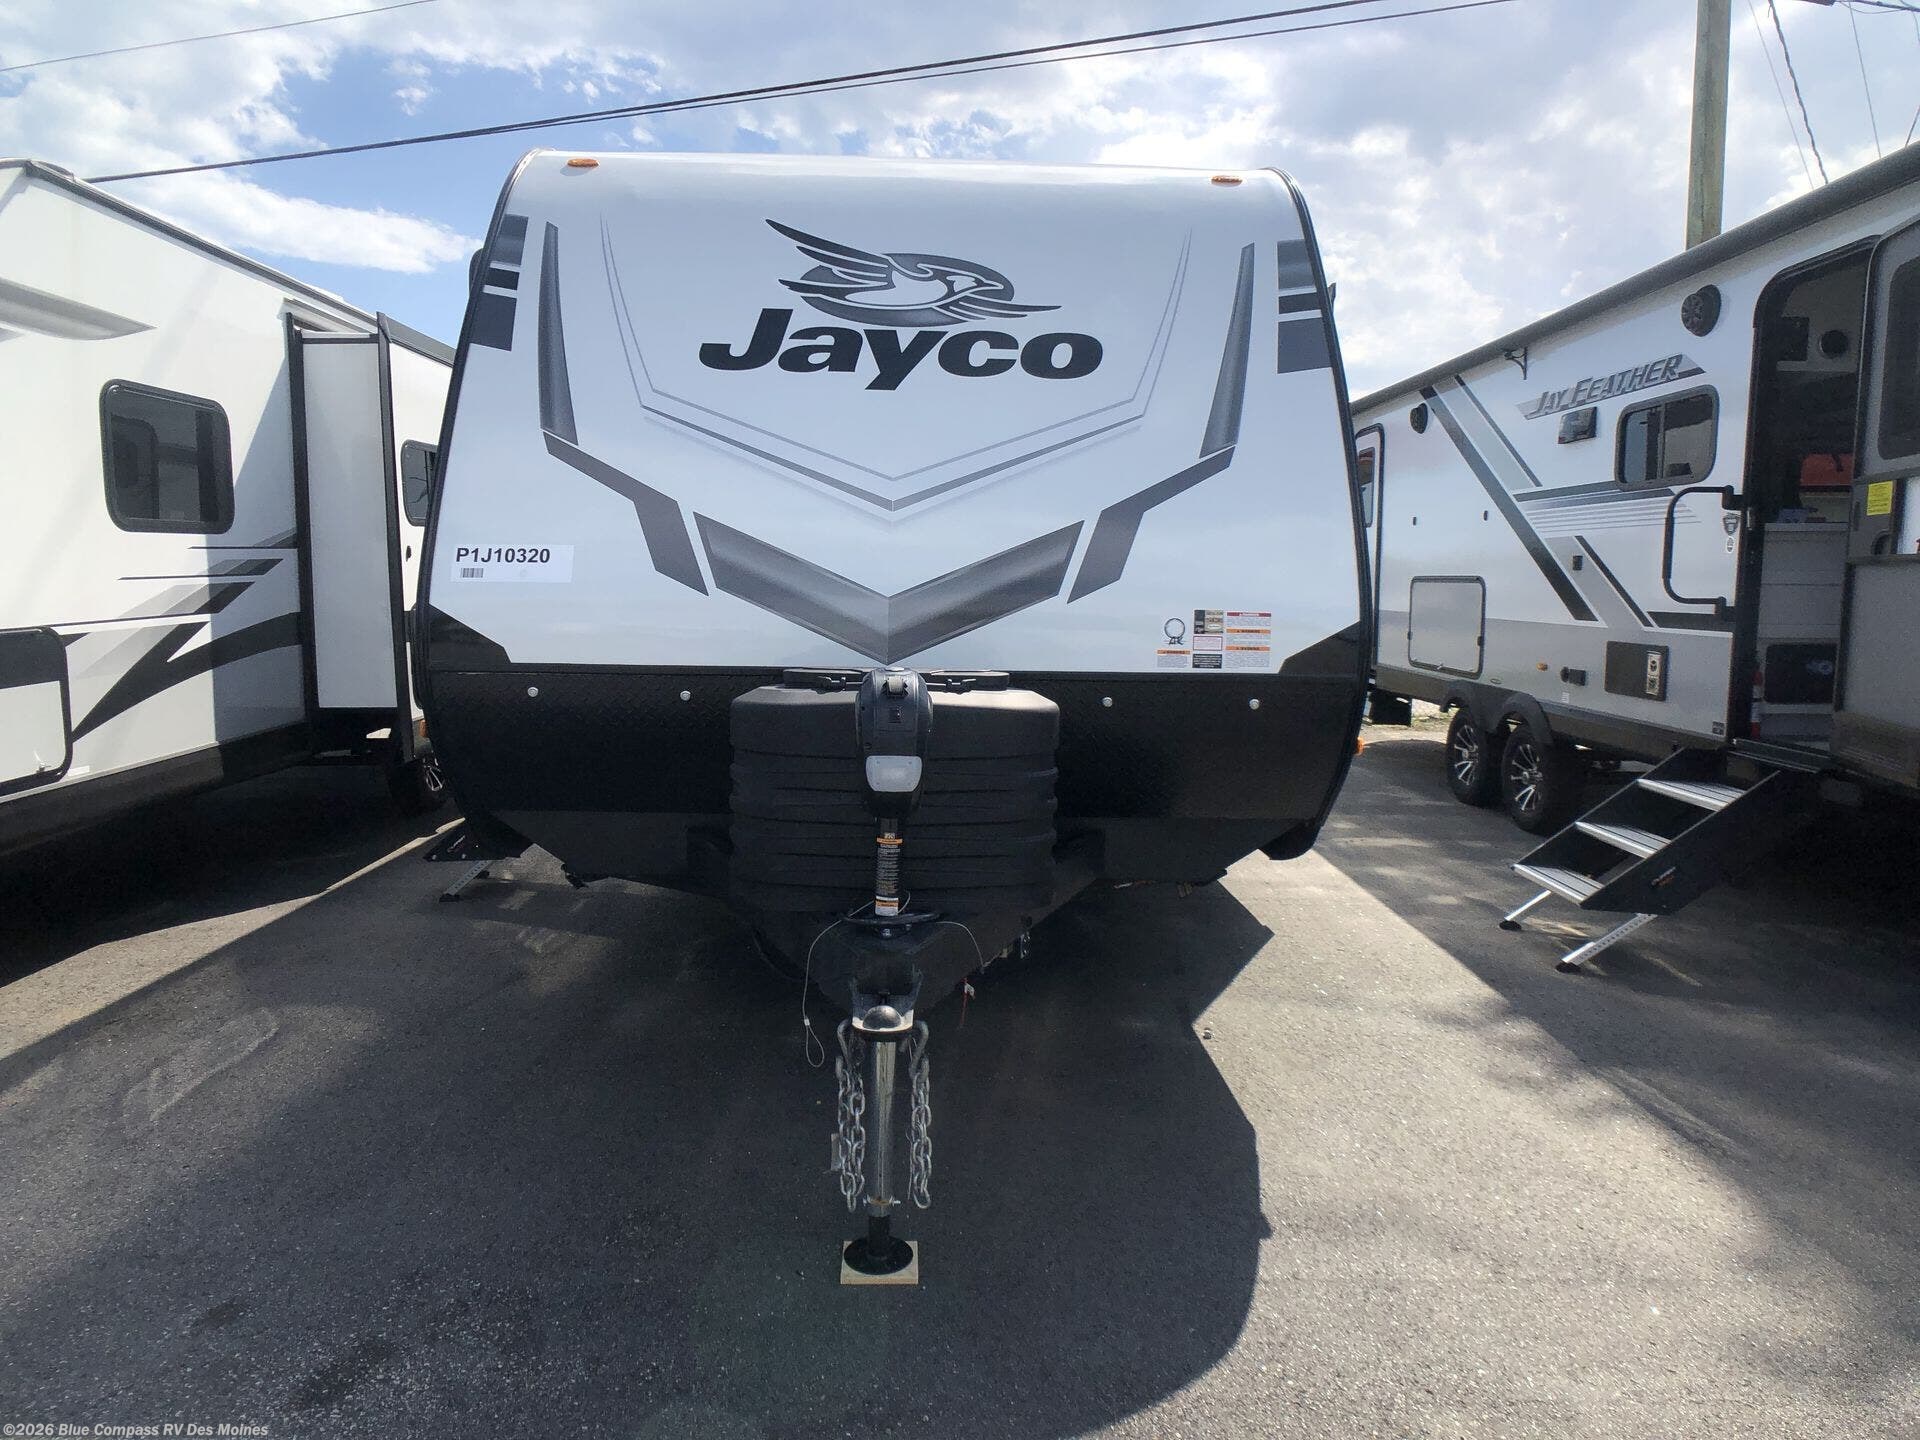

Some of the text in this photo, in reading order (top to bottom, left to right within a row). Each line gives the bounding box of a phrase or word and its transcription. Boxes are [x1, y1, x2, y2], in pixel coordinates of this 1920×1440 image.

[699, 308, 1103, 390] Jayco
[1527, 354, 1683, 418] JAY FEATHER
[455, 547, 550, 563] P1J10320
